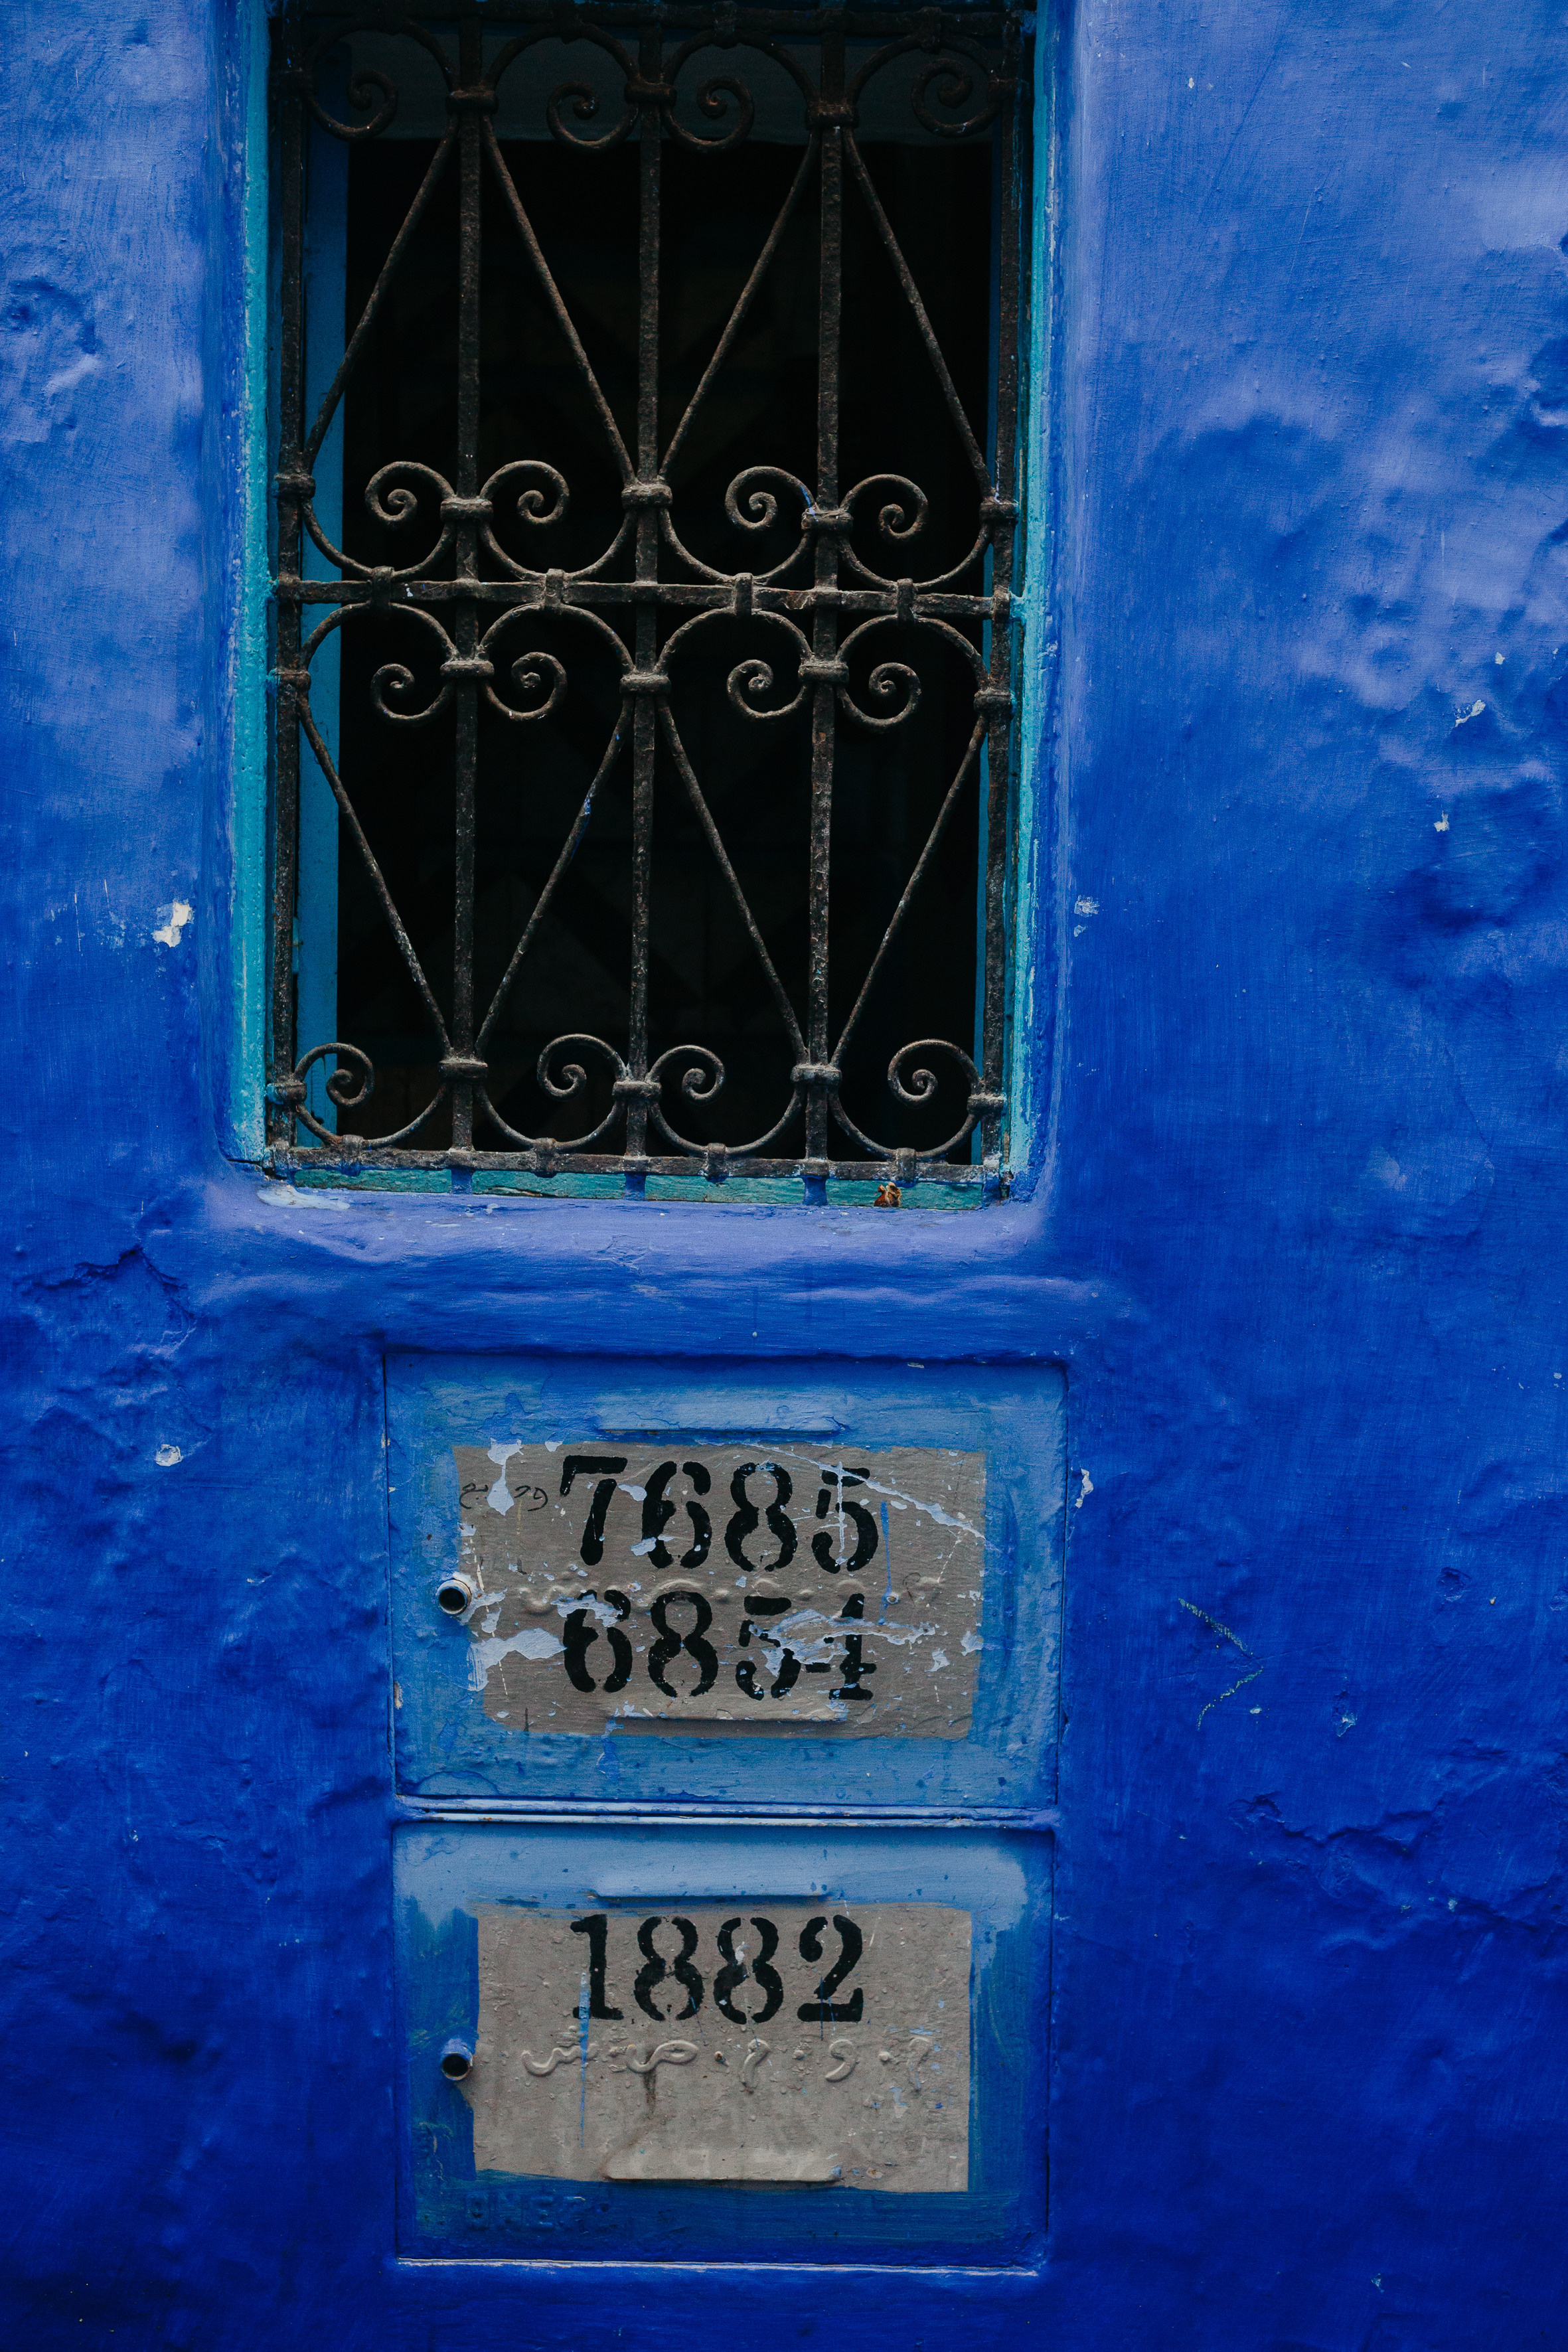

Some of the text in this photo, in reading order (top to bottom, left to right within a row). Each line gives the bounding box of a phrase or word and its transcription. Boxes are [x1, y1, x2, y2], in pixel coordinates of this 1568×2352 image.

[558, 1454, 880, 1576] 7685
[562, 1589, 878, 1701] 6854
[570, 1914, 864, 2025] 1882
